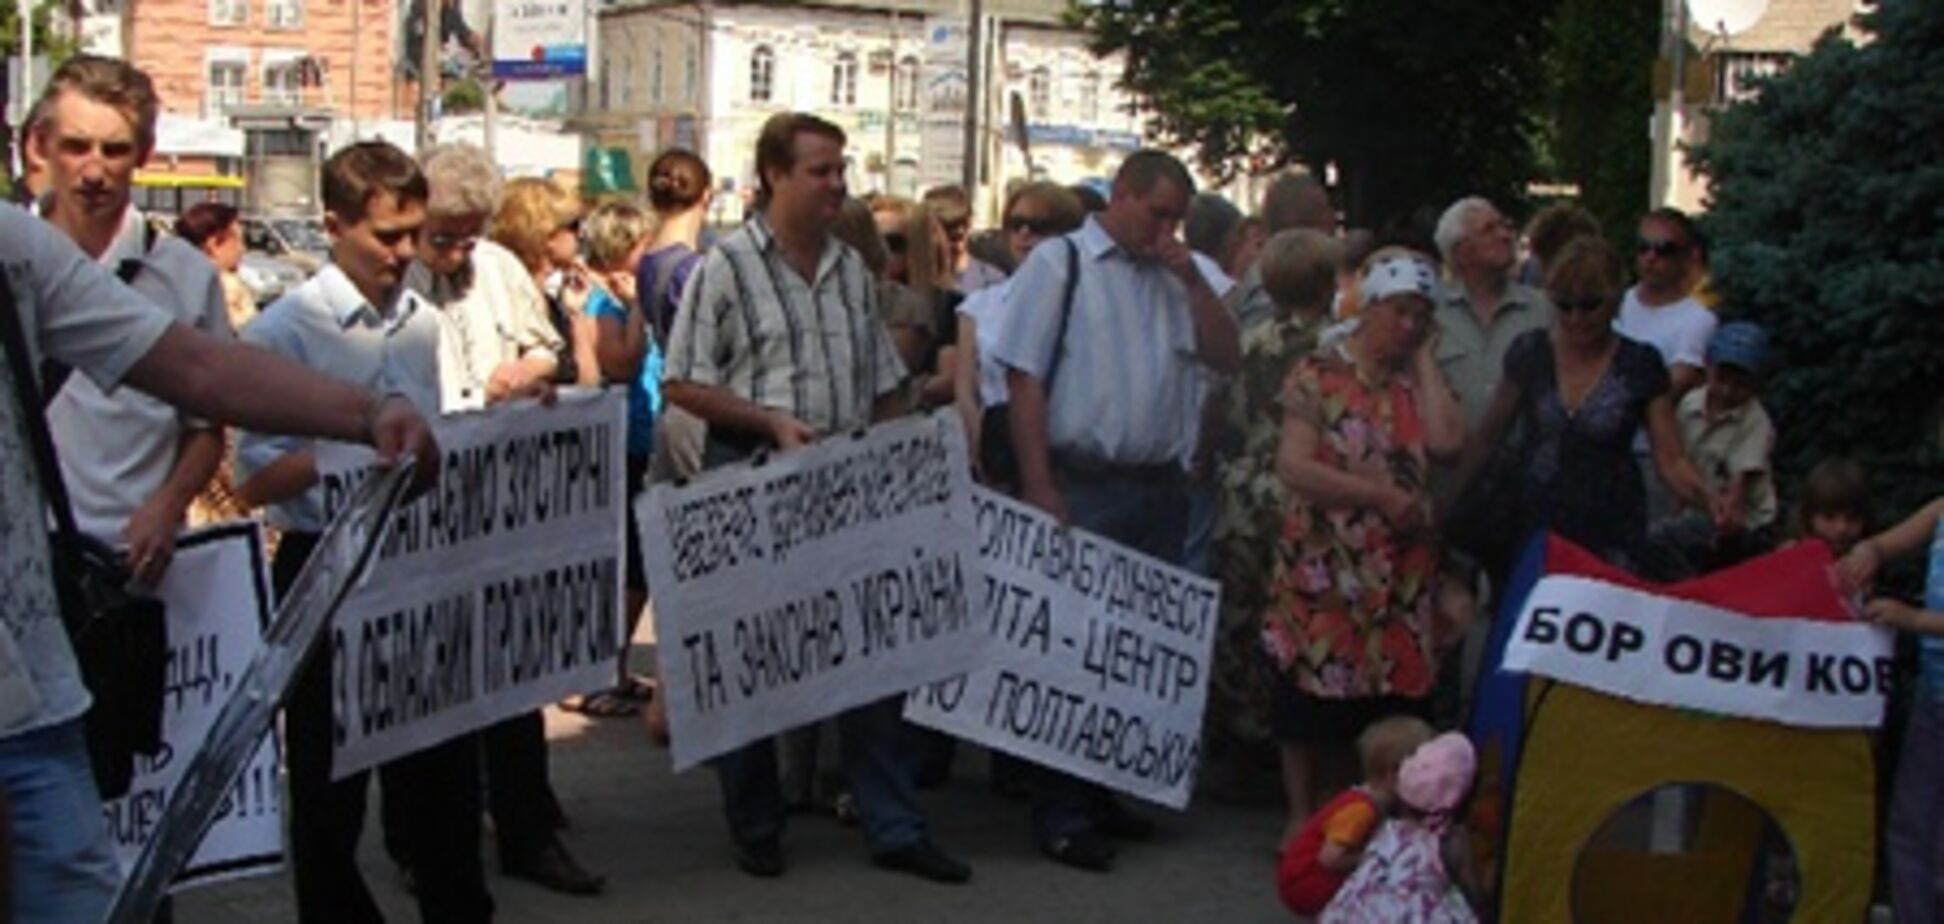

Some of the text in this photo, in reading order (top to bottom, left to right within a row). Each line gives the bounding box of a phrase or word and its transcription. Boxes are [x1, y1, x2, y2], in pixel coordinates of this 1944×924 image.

[971, 494, 1216, 642] ОЛТАВАБУДІНВЕСТ
[682, 547, 970, 713] ТА ЗАКОНІВ УКРАЇНИ
[1082, 617, 1199, 704] ЦЕНТР
[1523, 605, 1646, 663] БОР
[1663, 633, 1790, 689] ОВИ
